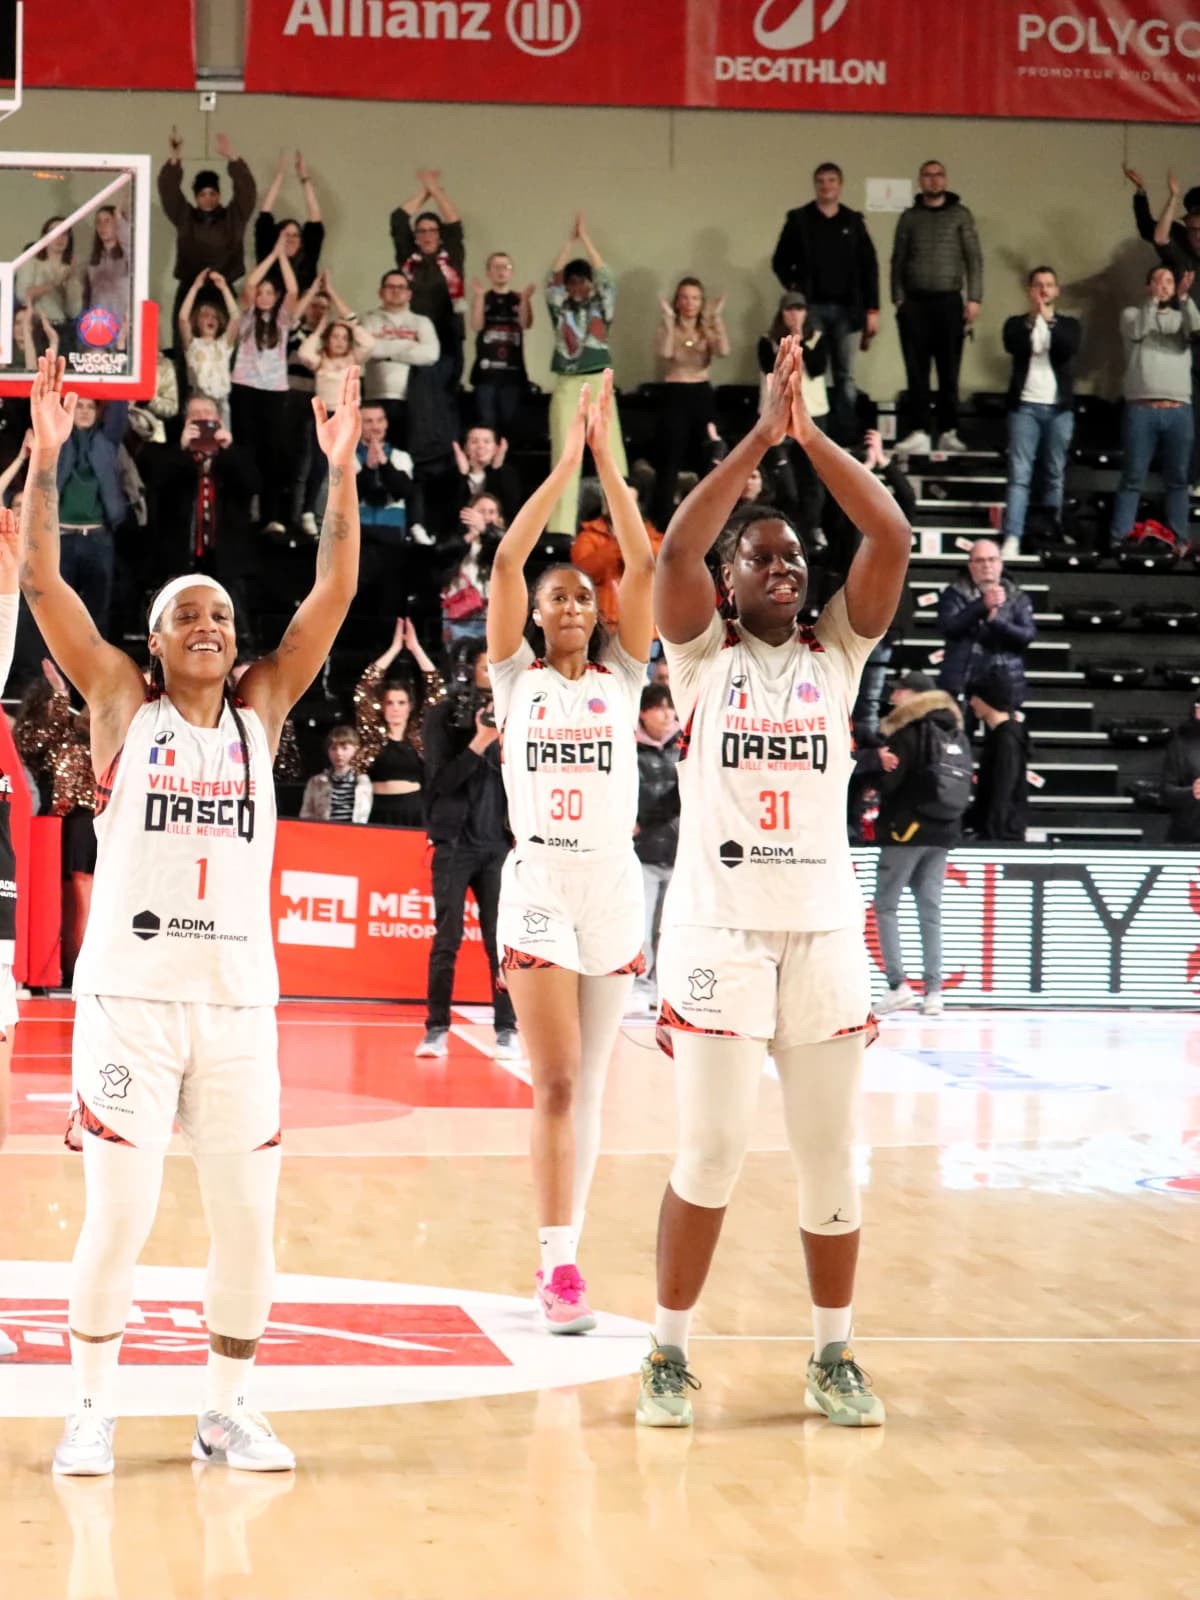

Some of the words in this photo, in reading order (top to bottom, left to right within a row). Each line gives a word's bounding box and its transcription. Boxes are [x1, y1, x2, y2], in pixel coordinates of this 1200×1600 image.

[282, 0, 492, 41] Allianz
[714, 56, 888, 85] DECATHLON
[1018, 66, 1113, 79] PROMOTEUR
[68, 352, 128, 363] EUROCUP
[73, 362, 121, 373] WOMEN
[726, 714, 827, 733] VILLENEUVE
[526, 741, 612, 775] D'ASCQ
[722, 732, 828, 774] D'ASCQ
[148, 773, 256, 797] VILLENEUVE
[550, 788, 582, 821] 30
[758, 790, 791, 830] 31
[144, 792, 255, 844] D'ASCQ
[166, 824, 191, 835] LILLE
[750, 846, 794, 857] ADIM
[195, 858, 208, 900] 1
[286, 896, 356, 924] MEL
[166, 931, 248, 942] HAUTS-DE-FRANCE
[167, 918, 215, 931] ADIM
